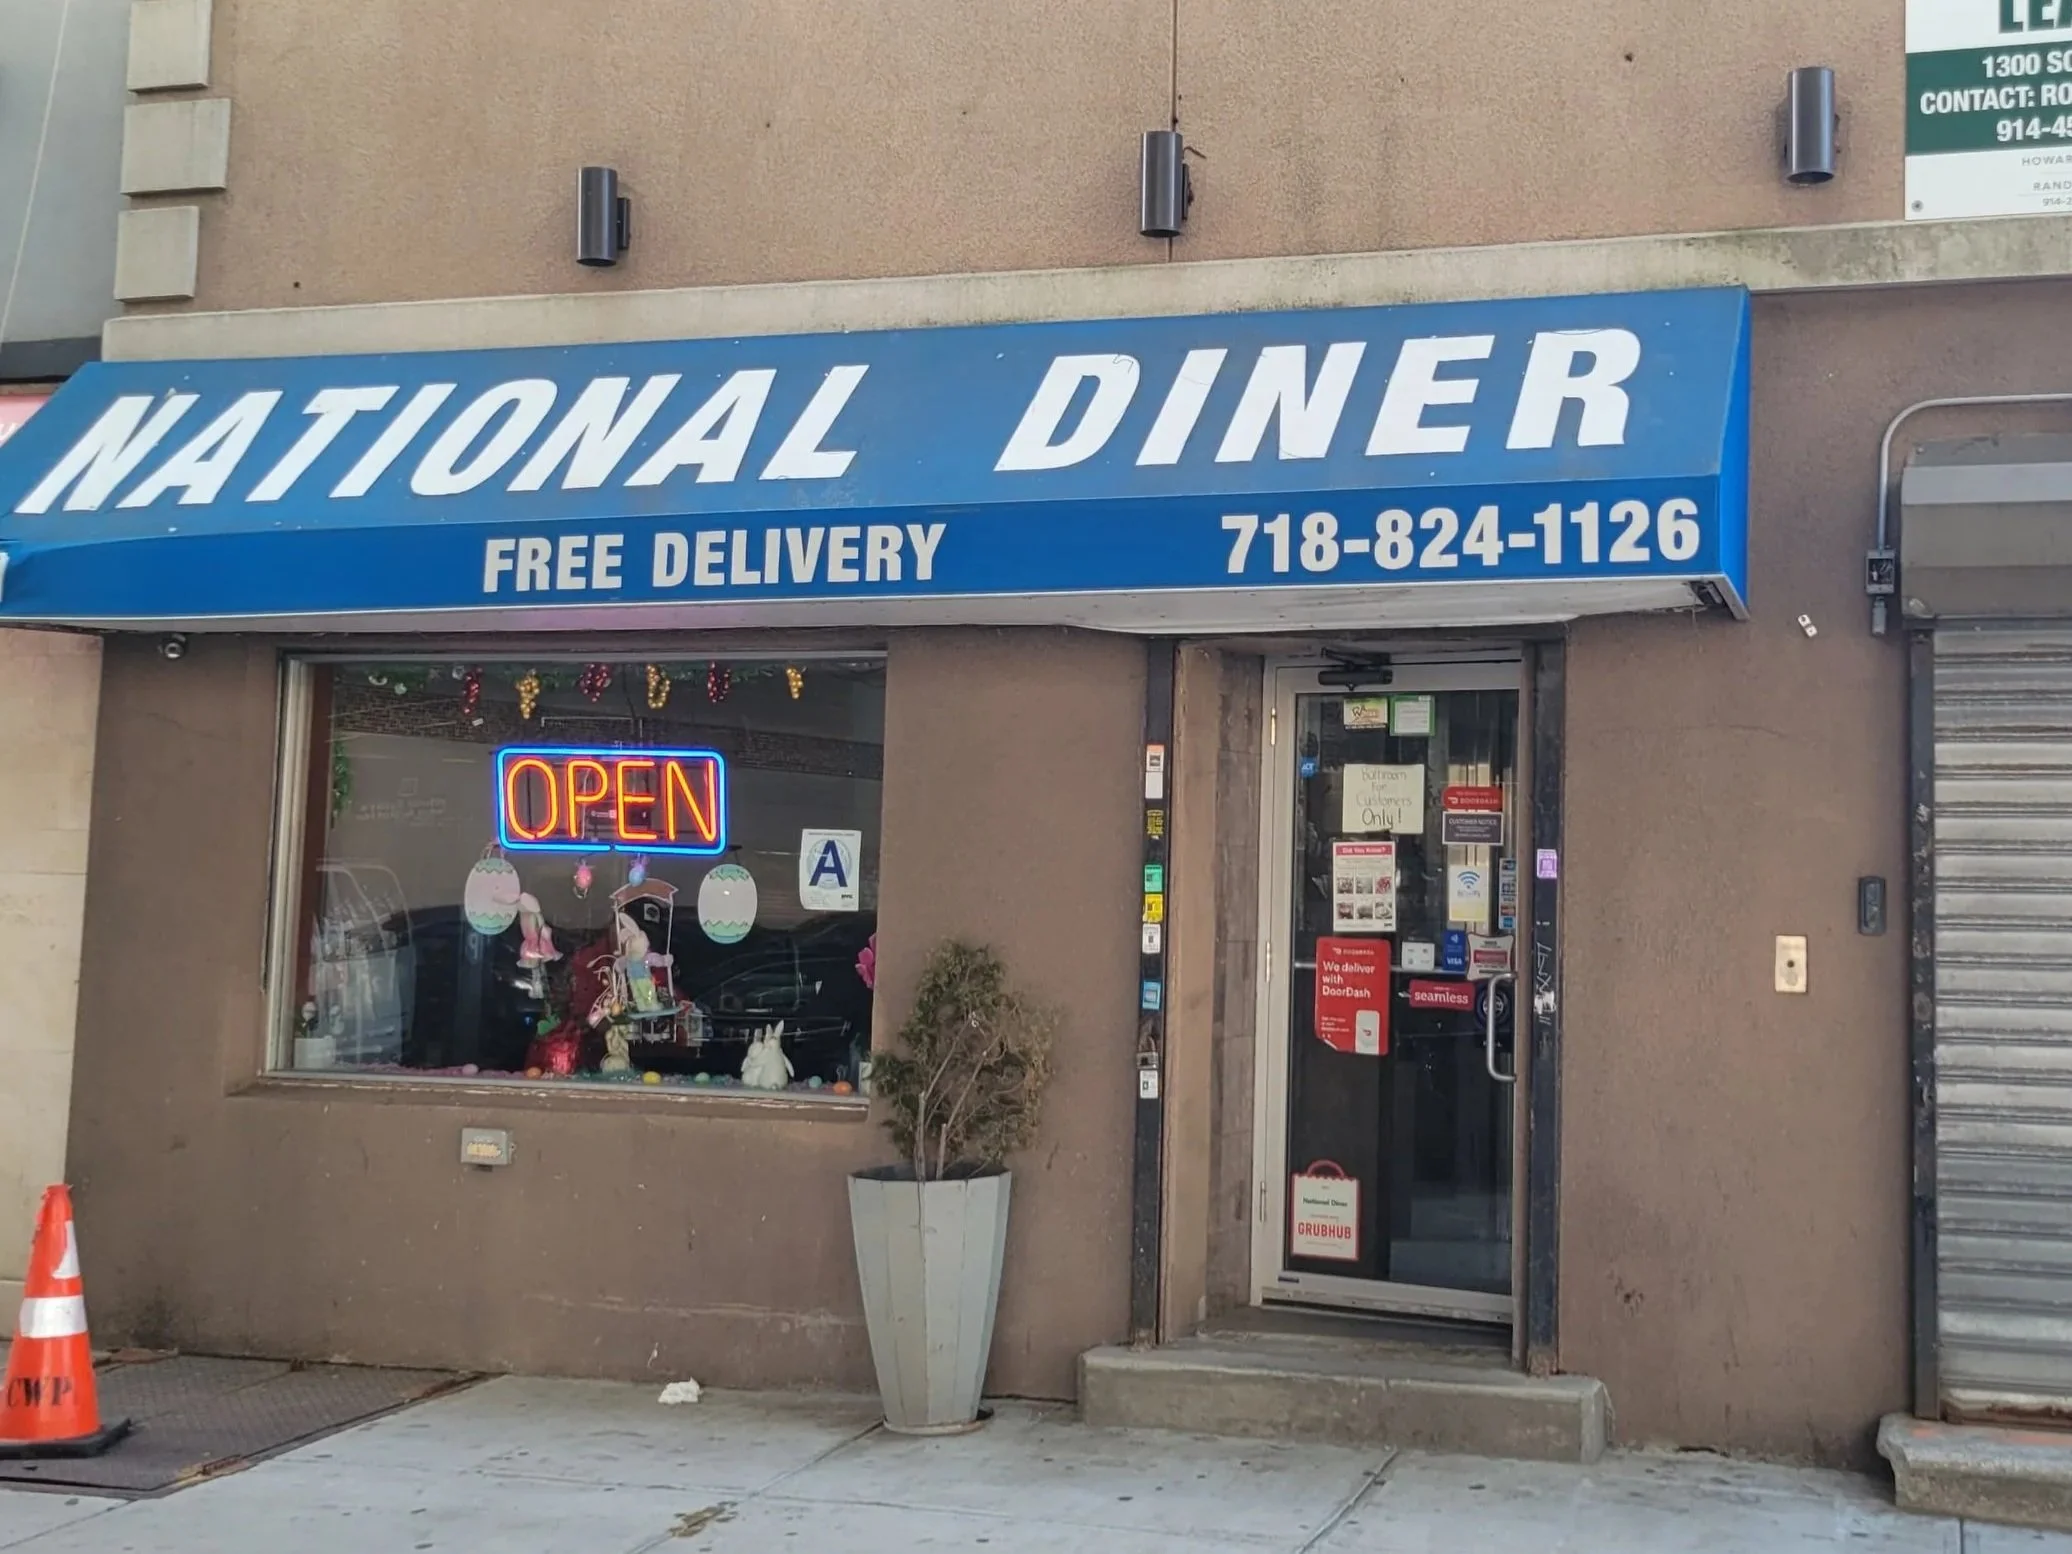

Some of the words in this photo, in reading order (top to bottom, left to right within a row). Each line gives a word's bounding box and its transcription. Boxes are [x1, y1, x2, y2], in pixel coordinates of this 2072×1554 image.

[1982, 53, 2041, 79] 1300
[1920, 86, 2036, 115] CONTACT:
[2041, 82, 2072, 107] RO
[14, 364, 869, 515] NATIONAL
[993, 327, 1641, 472] DINER
[1221, 497, 1701, 574] 718-824-1126
[483, 533, 624, 594] FREE
[652, 522, 947, 589] DELIVERY
[506, 757, 718, 842] OPEN
[808, 840, 848, 888] A
[1322, 974, 1344, 984] with
[1323, 961, 1341, 972] We
[1341, 962, 1375, 974] deliver
[1322, 986, 1371, 998] DoorDash
[1414, 991, 1469, 1004] seamless
[1298, 1222, 1352, 1239] GRUBHUB
